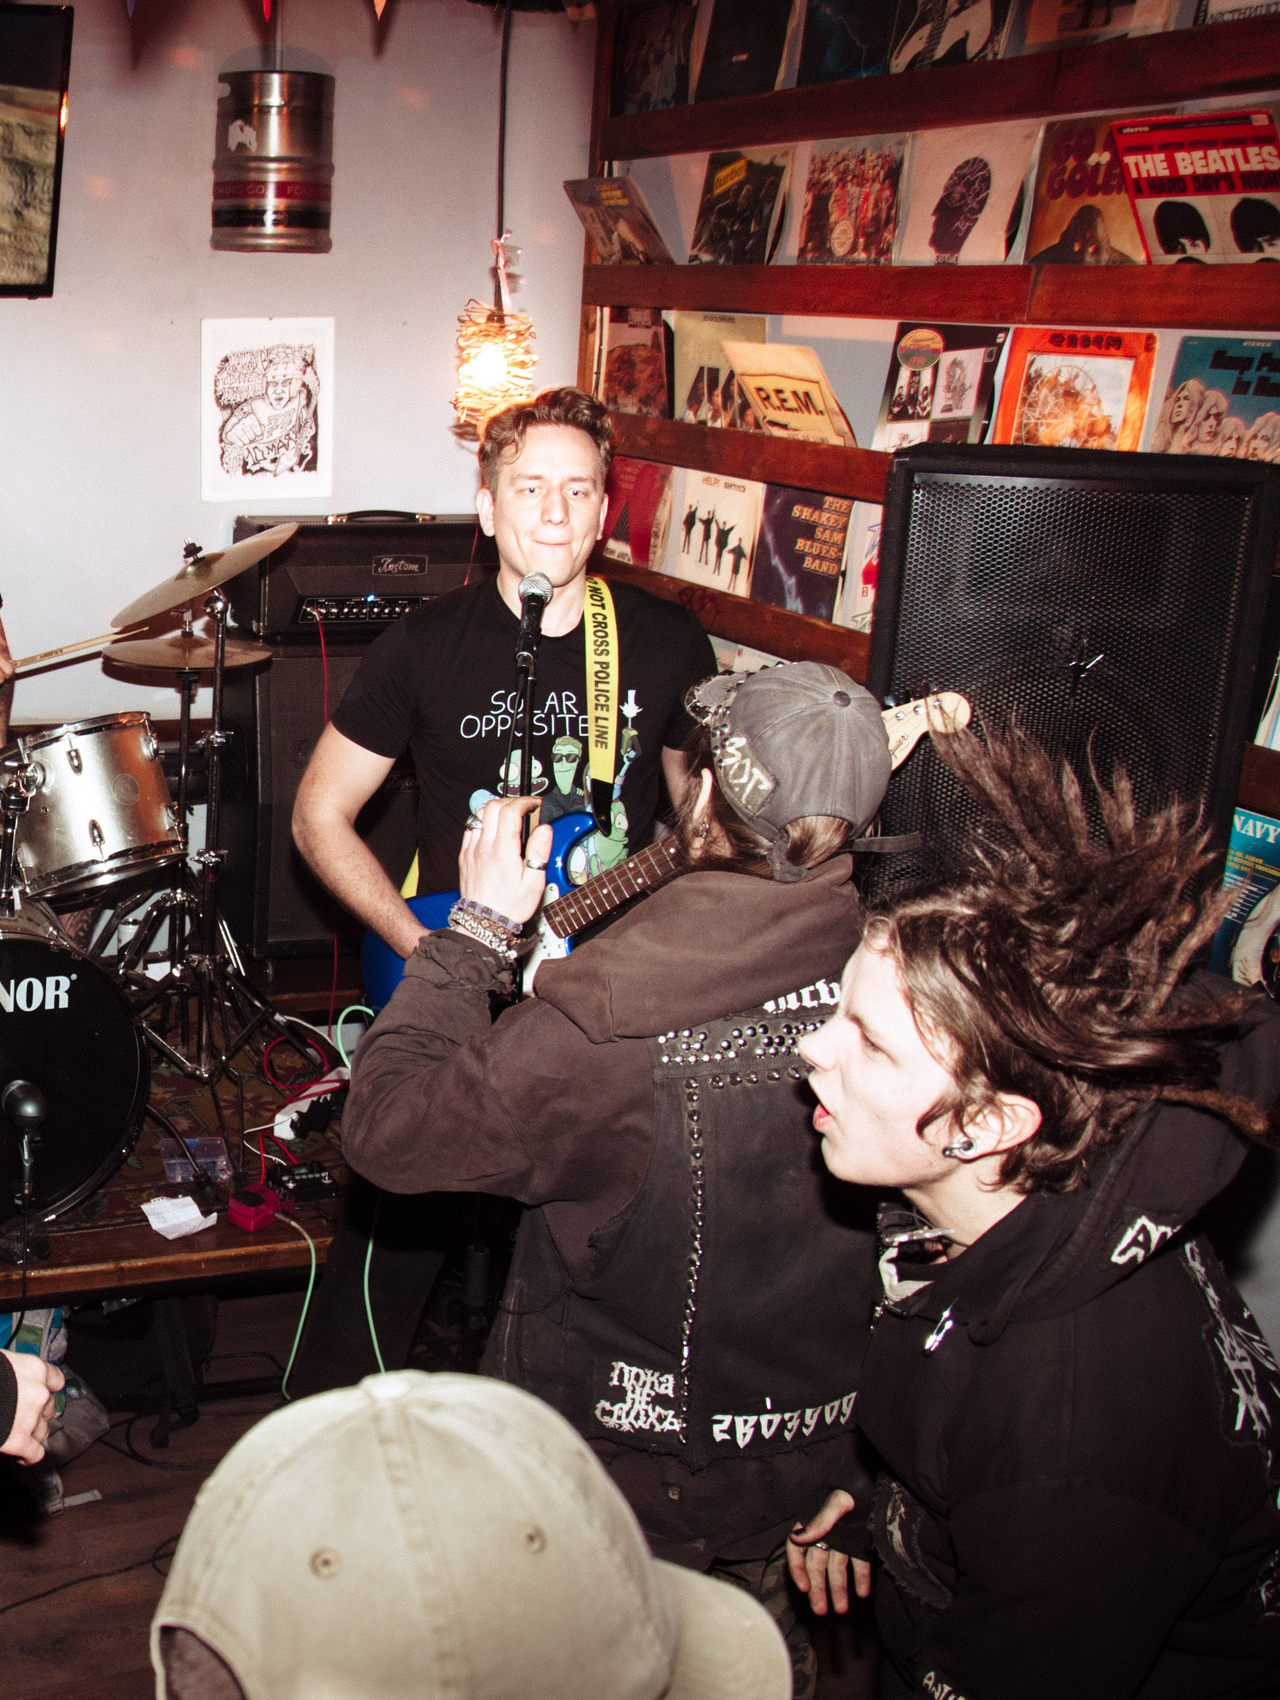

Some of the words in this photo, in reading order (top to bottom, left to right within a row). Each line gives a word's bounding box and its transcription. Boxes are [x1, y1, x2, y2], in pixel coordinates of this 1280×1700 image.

[1123, 153, 1170, 178] THE
[1173, 146, 1280, 176] BEATLES
[754, 386, 824, 416] R.E.M.
[792, 505, 847, 530] SHAKEY
[824, 496, 851, 513] THE
[814, 527, 844, 545] SAM
[378, 557, 419, 573] Kustom
[803, 556, 838, 576] BAND
[587, 585, 606, 611] NOT
[592, 612, 610, 657] CROSS
[593, 661, 610, 711] POLICE
[490, 690, 579, 714] SOAR
[594, 714, 610, 749] LINE
[1233, 814, 1280, 843] NAVY
